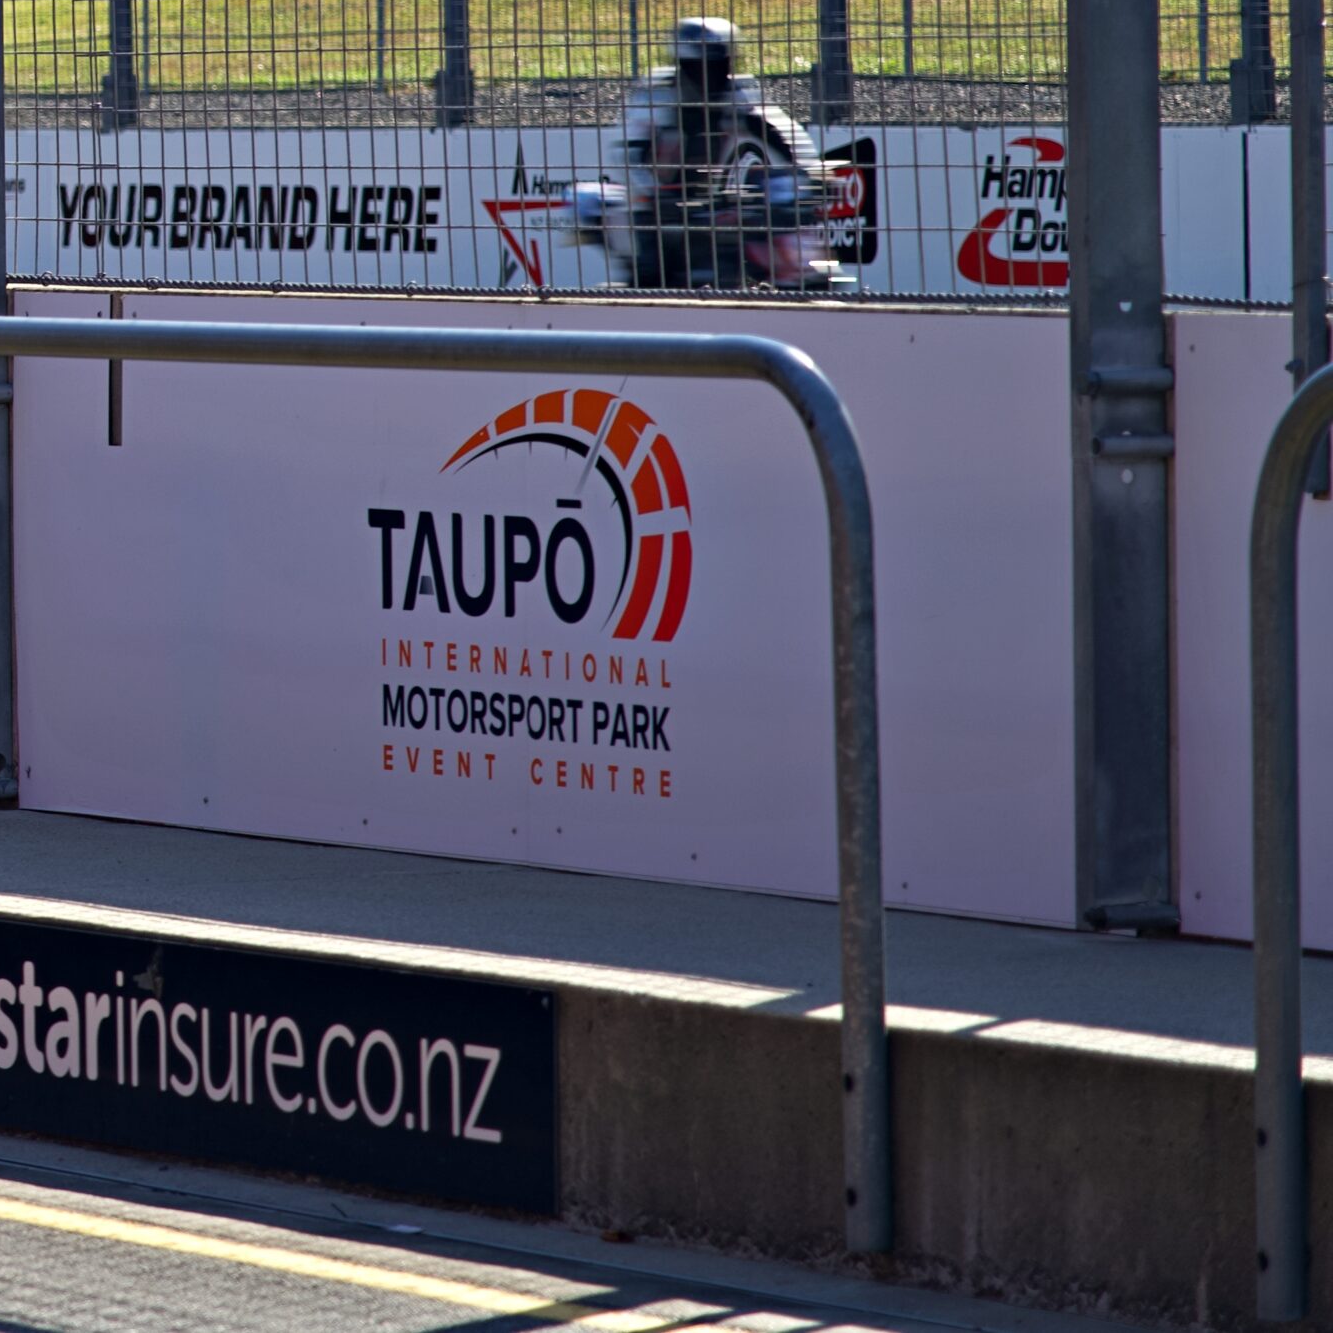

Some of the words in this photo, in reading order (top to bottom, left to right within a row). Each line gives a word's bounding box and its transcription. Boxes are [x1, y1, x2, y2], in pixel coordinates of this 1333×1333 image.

[981, 154, 1068, 212] Hamp
[59, 183, 163, 249] YOUR
[169, 184, 318, 251] BRAND
[325, 185, 441, 253] HERE
[818, 216, 867, 247] DDICT
[368, 498, 596, 624] TAUPŌ
[382, 638, 672, 689] INTERNATIONAL
[383, 683, 583, 744] MOTORSPORT
[592, 700, 671, 752] PARK
[383, 744, 496, 791] EVENT
[530, 758, 672, 798] CENTRE
